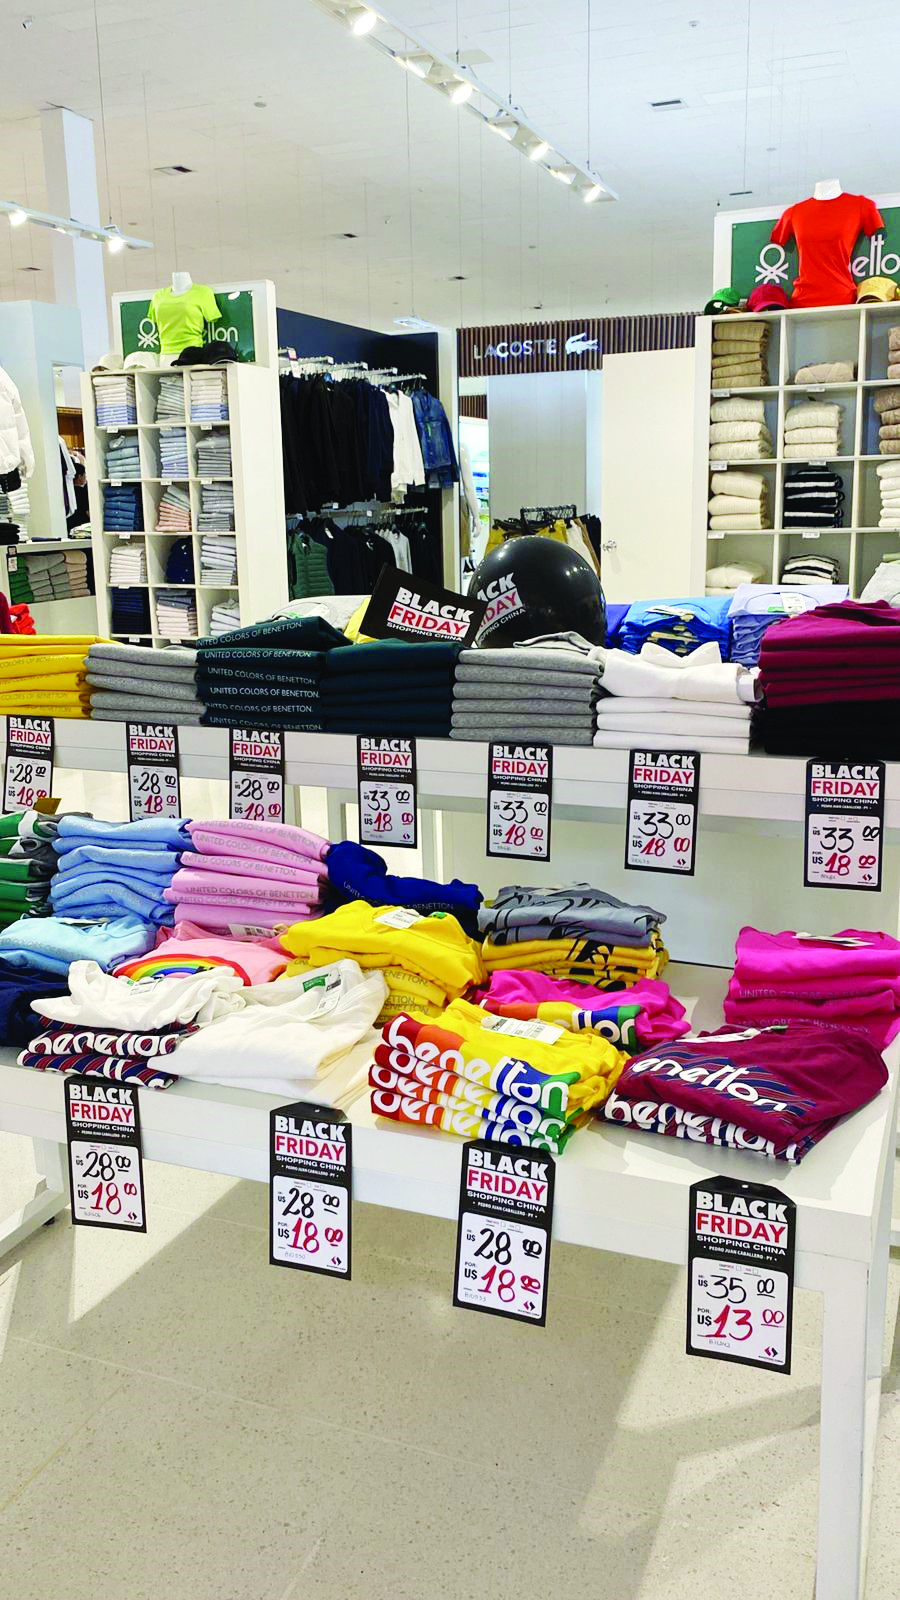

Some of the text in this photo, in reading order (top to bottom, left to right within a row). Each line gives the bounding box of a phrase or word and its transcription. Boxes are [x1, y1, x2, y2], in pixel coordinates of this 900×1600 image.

[474, 339, 557, 360] LACOSTE
[477, 572, 516, 602] ACK
[395, 586, 474, 622] BLACK
[388, 604, 467, 635] FRIDAY
[500, 608, 526, 624] CHINA
[220, 632, 250, 643] COLORS
[386, 621, 462, 641] SHOPPING CHINA
[204, 651, 231, 659] UNITED
[232, 651, 261, 659] COLORS
[207, 666, 234, 677] UNITED
[235, 671, 264, 680] COLORS
[210, 687, 238, 695] UNITED
[240, 688, 269, 696] COLORS
[271, 688, 280, 696] OF
[10, 717, 50, 731] BLACK
[129, 725, 174, 737] BLACK
[10, 730, 50, 744] FRIDAY
[130, 738, 173, 751] FRIDAY
[233, 729, 280, 744] BLACK
[361, 738, 411, 752] BLACK
[234, 743, 280, 757] FRIDAY
[361, 752, 411, 766] FRIDAY
[493, 745, 548, 760] BLACK
[634, 752, 695, 768] BLACK
[13, 764, 33, 784] 28
[493, 760, 547, 775] FRIDAY
[634, 768, 693, 784] FRIDAY
[812, 764, 879, 779] BLACK
[138, 772, 160, 794] 28
[237, 779, 263, 800] 28
[812, 781, 878, 796] FRIDAY
[17, 786, 34, 806] 18
[144, 795, 162, 814] 18
[368, 790, 390, 811] 33
[241, 802, 264, 821] 18
[374, 812, 392, 832] 18
[499, 800, 528, 823] 33
[502, 823, 525, 846] 18
[638, 812, 673, 839] 33
[640, 838, 665, 856] 18
[820, 827, 854, 853] 33
[824, 853, 851, 876] 18
[219, 887, 255, 896] COLORS
[388, 1016, 568, 1109] benetton
[69, 1084, 133, 1105] BLACK
[632, 1058, 788, 1112] enetton
[71, 1103, 133, 1123] FRIDAY
[72, 1122, 134, 1133] SHOPPING CHINA
[275, 1115, 345, 1142] BLACK
[276, 1135, 345, 1162] FRIDAY
[82, 1151, 115, 1181] 28
[276, 1155, 318, 1167] SHOPPING
[320, 1162, 345, 1172] CHINA
[468, 1148, 548, 1181] BLACK
[468, 1169, 546, 1201] FRIDAY
[90, 1182, 122, 1215] 18
[282, 1187, 314, 1218] 28
[467, 1191, 545, 1213] SHOPPING CHINA
[696, 1190, 788, 1223] BLACK
[287, 1217, 319, 1253] 18
[697, 1213, 786, 1244] FRIDAY
[474, 1228, 512, 1265] 28
[697, 1235, 786, 1256] SHOPPING CHINA
[478, 1265, 515, 1302] 18
[706, 1274, 747, 1304] 35
[705, 1304, 753, 1341] 13
